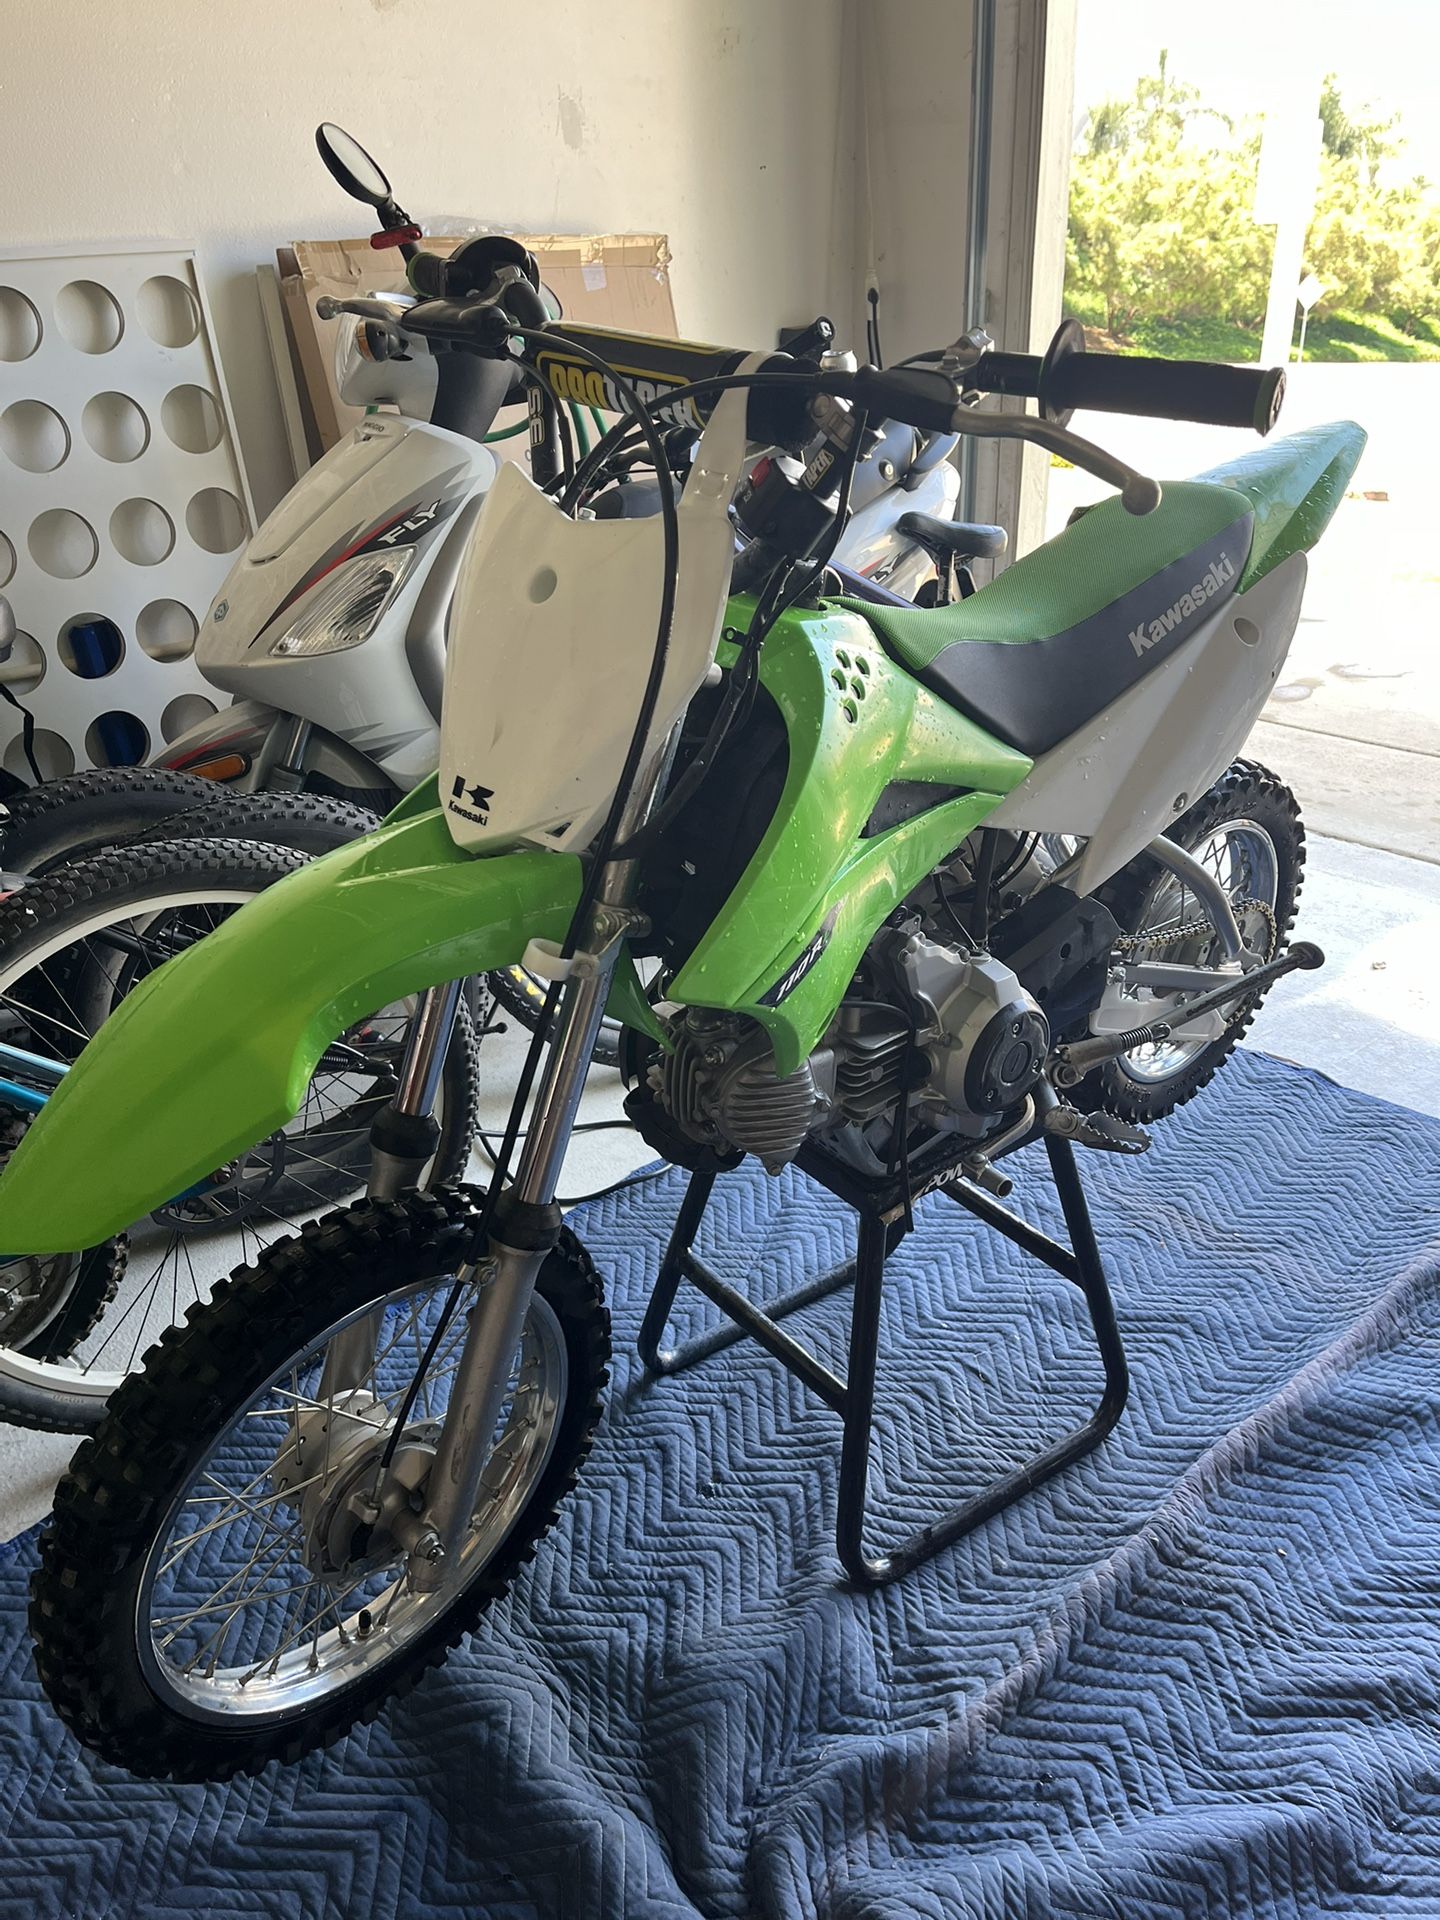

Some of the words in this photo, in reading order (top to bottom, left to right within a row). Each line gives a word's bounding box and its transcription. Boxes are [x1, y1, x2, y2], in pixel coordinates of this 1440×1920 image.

[378, 501, 440, 543] FLY
[1128, 552, 1235, 657] Kawasaki
[448, 800, 488, 826] Kawasaki
